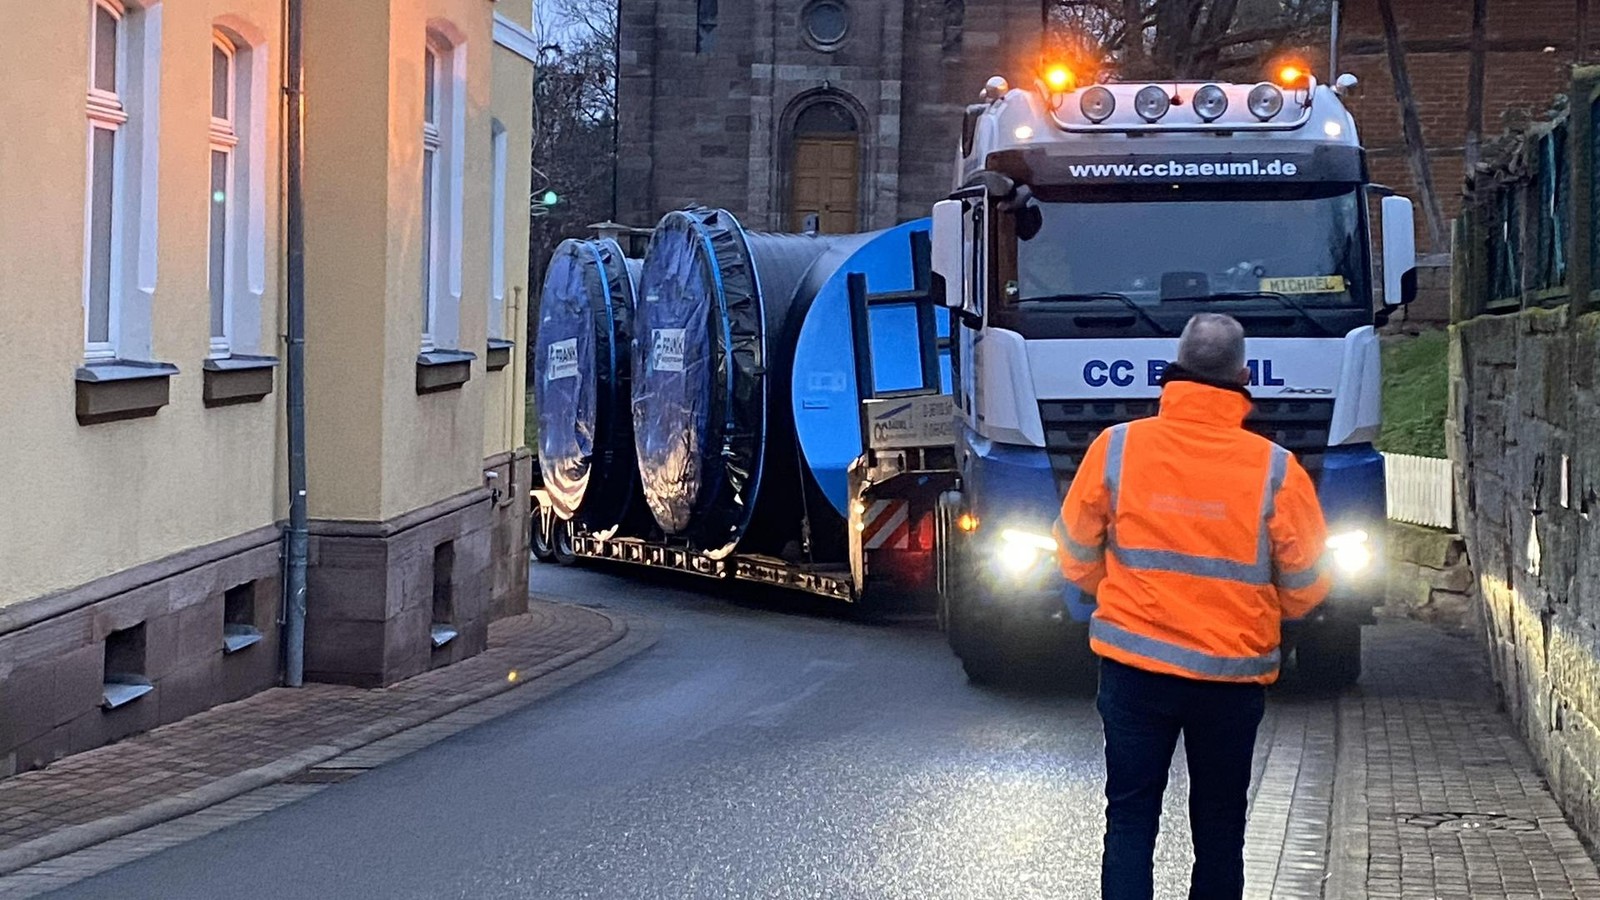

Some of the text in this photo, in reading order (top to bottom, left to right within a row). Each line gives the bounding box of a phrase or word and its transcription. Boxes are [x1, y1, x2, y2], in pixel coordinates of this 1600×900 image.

[1069, 159, 1298, 177] www.ccbaeuml.de
[1270, 278, 1335, 292] MICHAEL
[1083, 360, 1134, 386] CC
